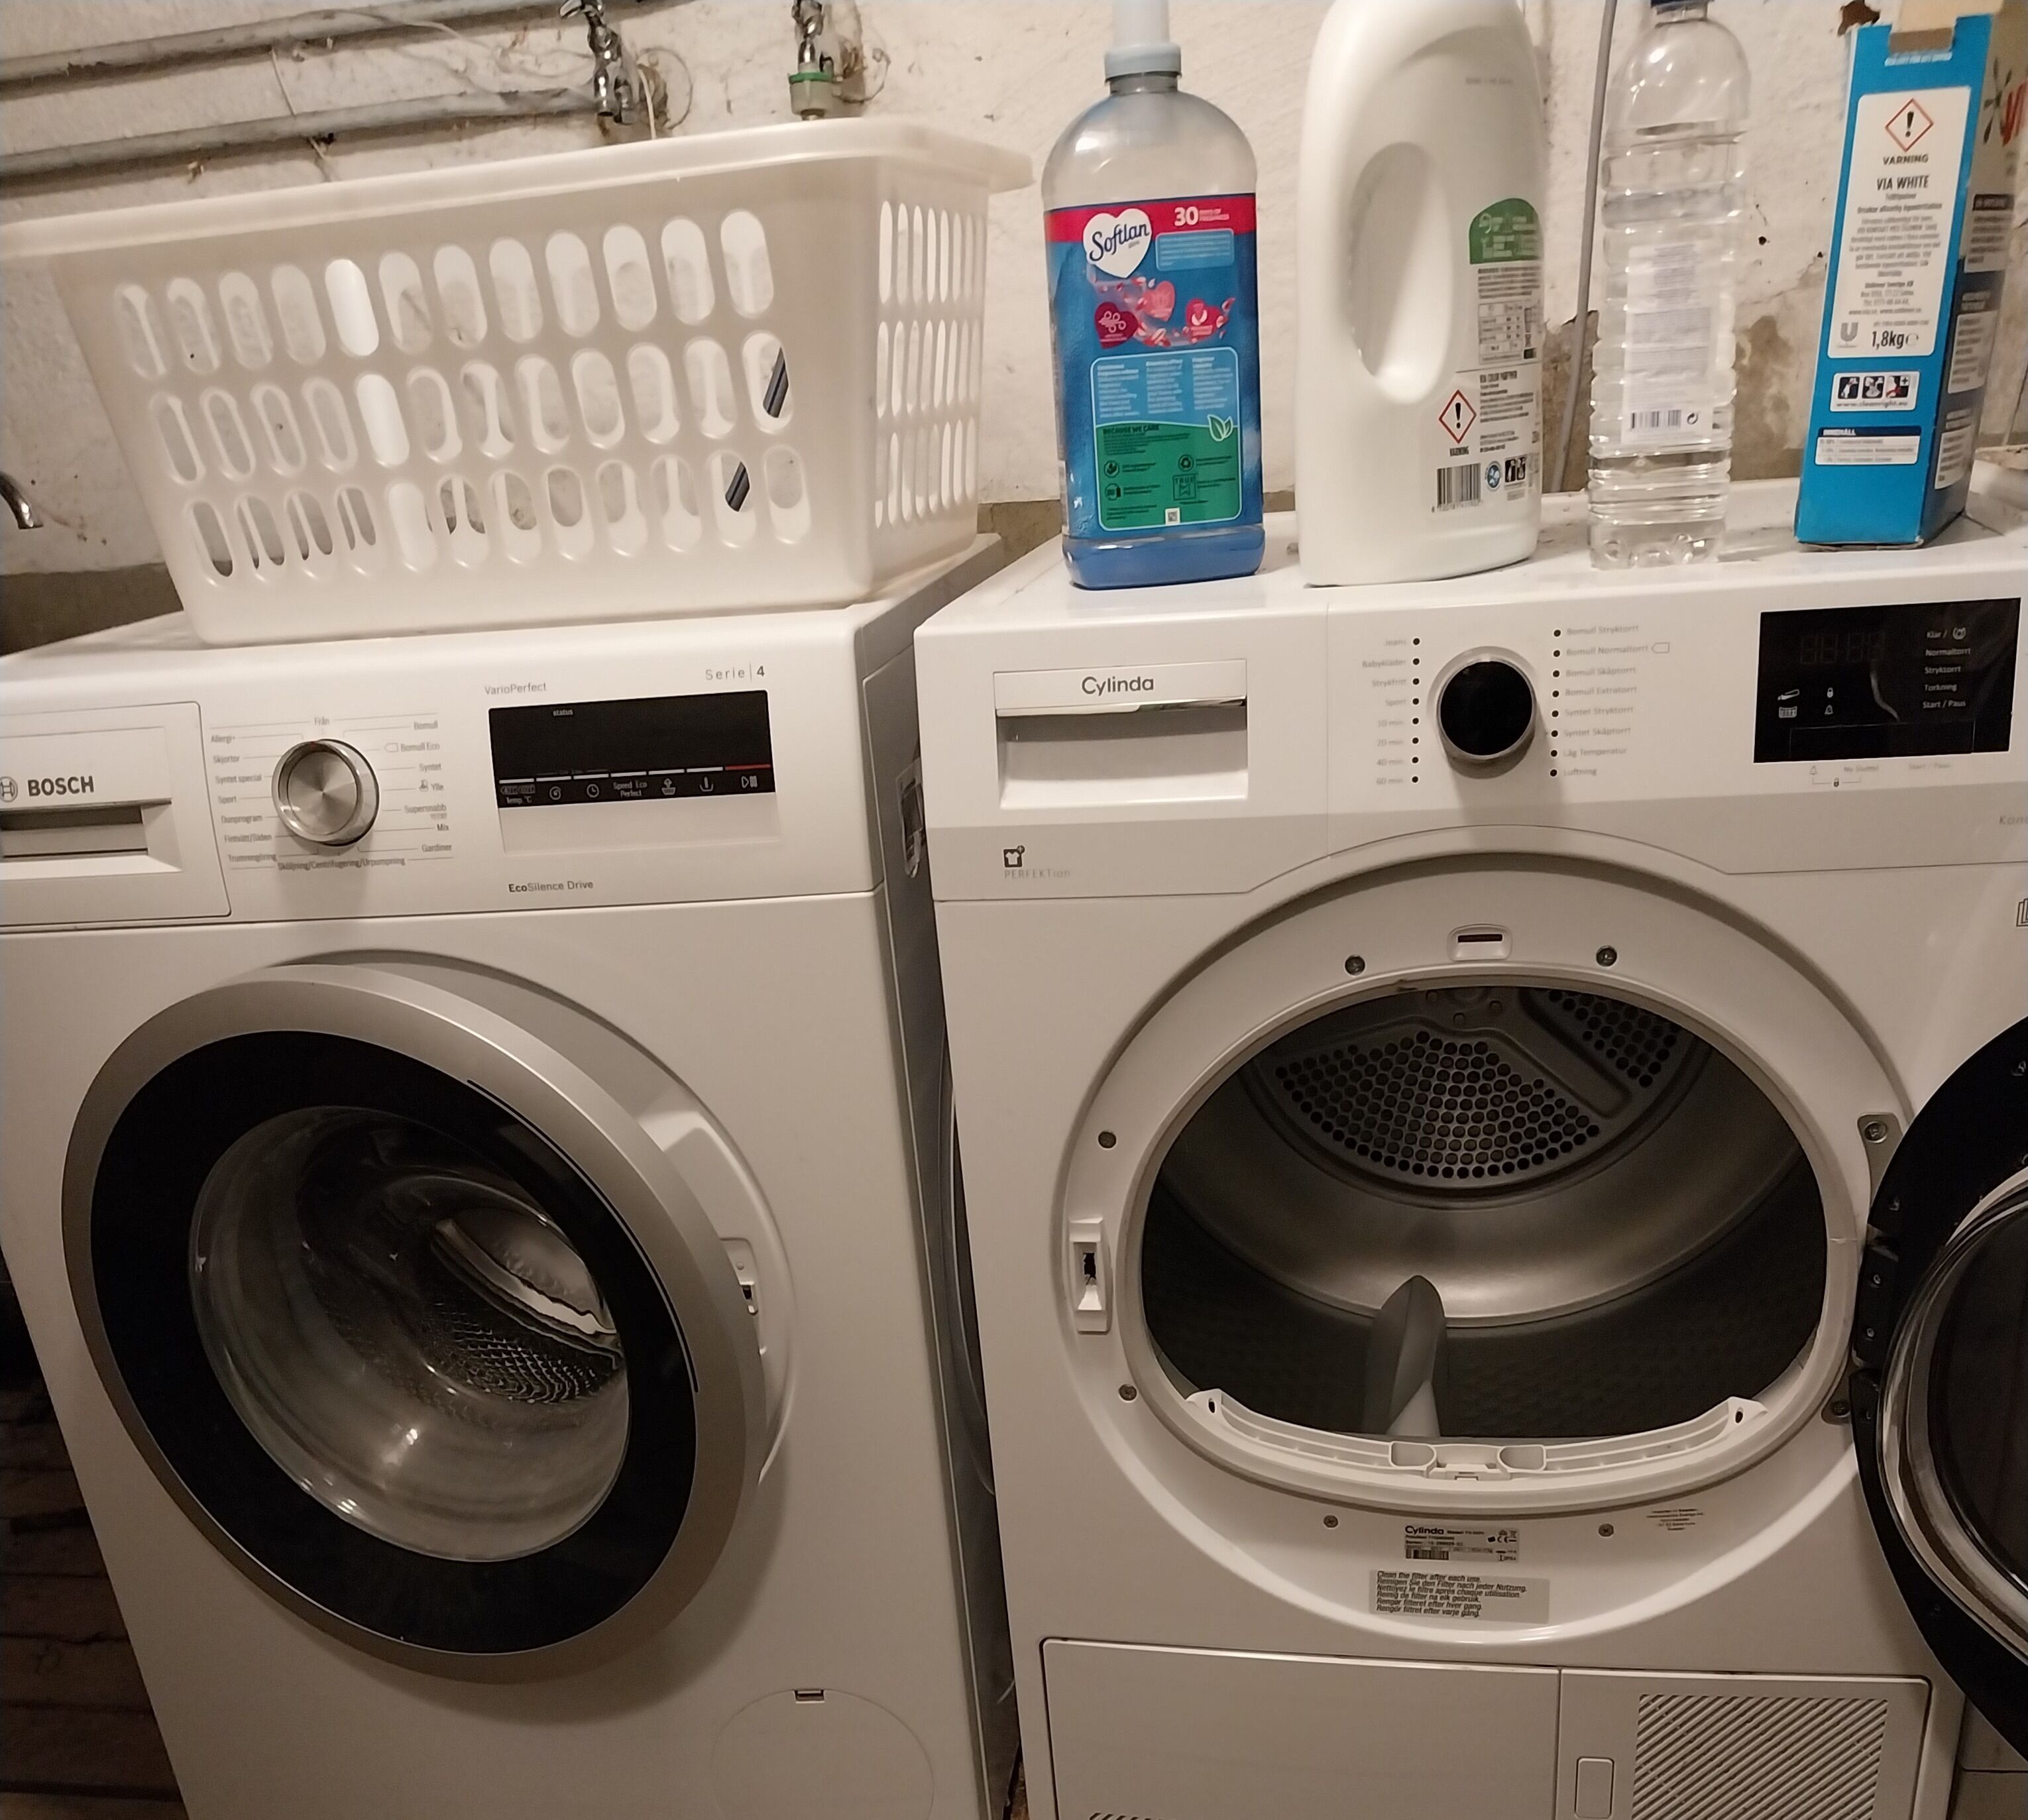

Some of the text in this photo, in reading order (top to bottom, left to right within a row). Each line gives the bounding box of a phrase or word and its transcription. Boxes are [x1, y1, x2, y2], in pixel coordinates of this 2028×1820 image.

[1883, 154, 1929, 166] VARNING
[1877, 175, 1929, 191] VIA WHITE
[1174, 206, 1199, 226] 30
[1089, 222, 1150, 261] Softlan
[705, 665, 765, 681] Serie 4
[484, 682, 547, 695] VarioPerfect
[1082, 676, 1155, 696] Cylinda
[1385, 699, 1406, 707] Sport
[314, 716, 329, 726] Från
[414, 720, 438, 730] Bomull
[401, 742, 440, 752] Bomull Eco
[213, 755, 240, 765] Skjortor
[419, 764, 441, 772] Syntet
[1563, 768, 1597, 777] Luftning
[28, 775, 94, 797] BOSCH
[218, 796, 237, 805] Sport
[404, 803, 447, 813] Supersnabb
[221, 815, 262, 824] Dunprogram
[508, 880, 594, 893] EcoSilence Drive
[1405, 1525, 1444, 1534] Cylinda
